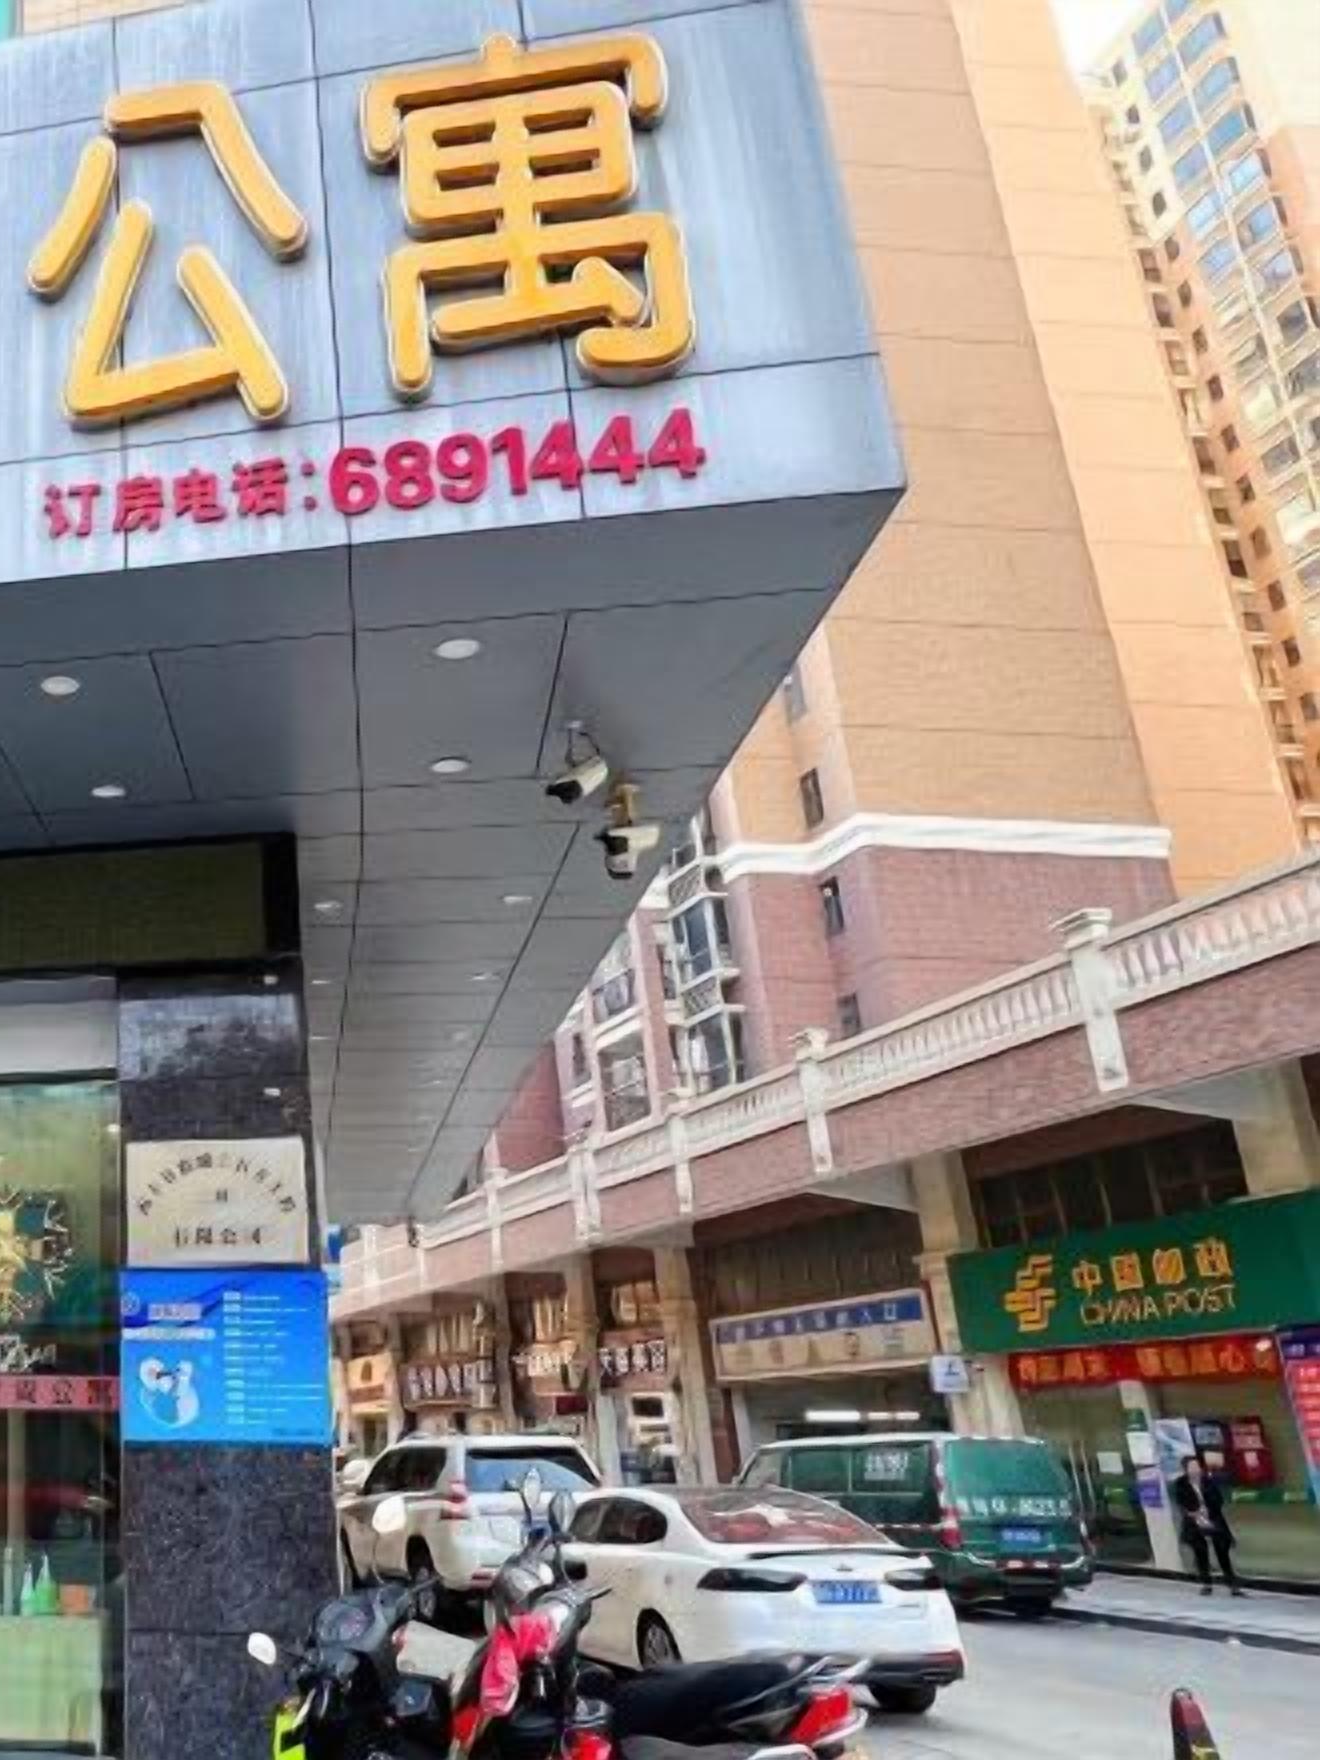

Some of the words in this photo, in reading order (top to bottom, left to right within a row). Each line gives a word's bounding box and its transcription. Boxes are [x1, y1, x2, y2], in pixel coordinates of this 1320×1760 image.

[44, 408, 706, 538] 订房电话:6891444
[1164, 1284, 1236, 1318] POST
